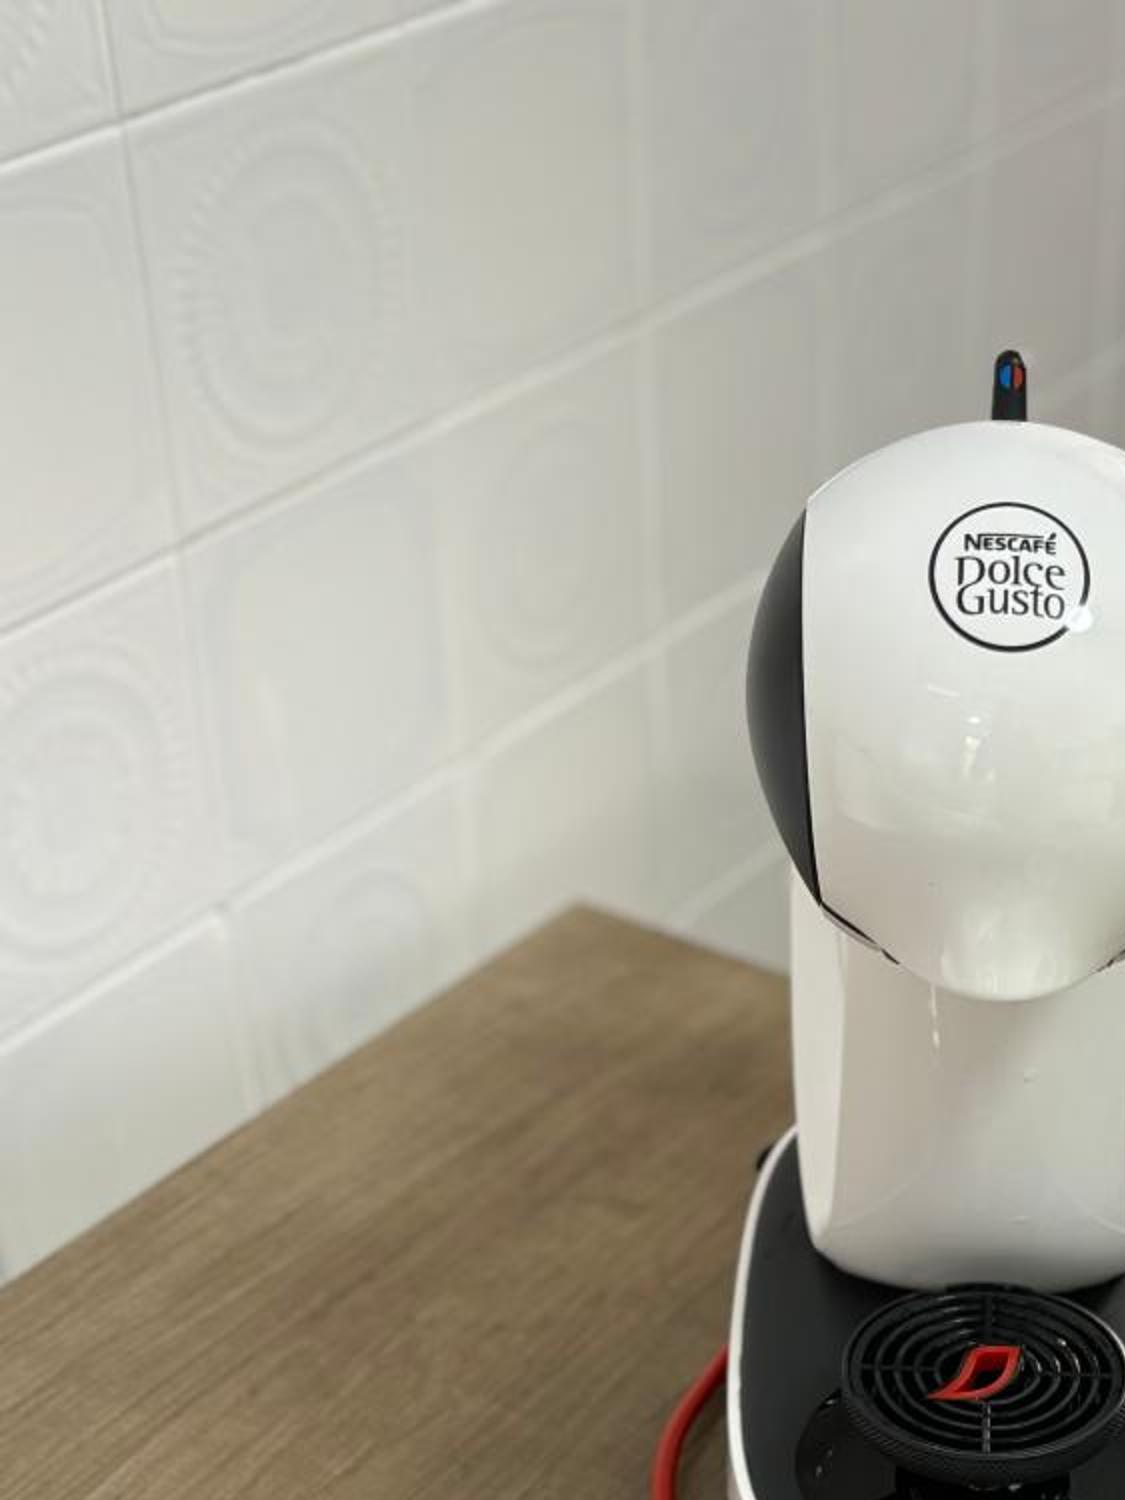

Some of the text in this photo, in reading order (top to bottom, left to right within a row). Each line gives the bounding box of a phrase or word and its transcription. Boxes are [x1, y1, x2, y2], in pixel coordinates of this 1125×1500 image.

[963, 532, 1058, 555] NESCAFÉ
[954, 555, 1066, 590] Dolce
[955, 585, 1066, 620] Gusto
